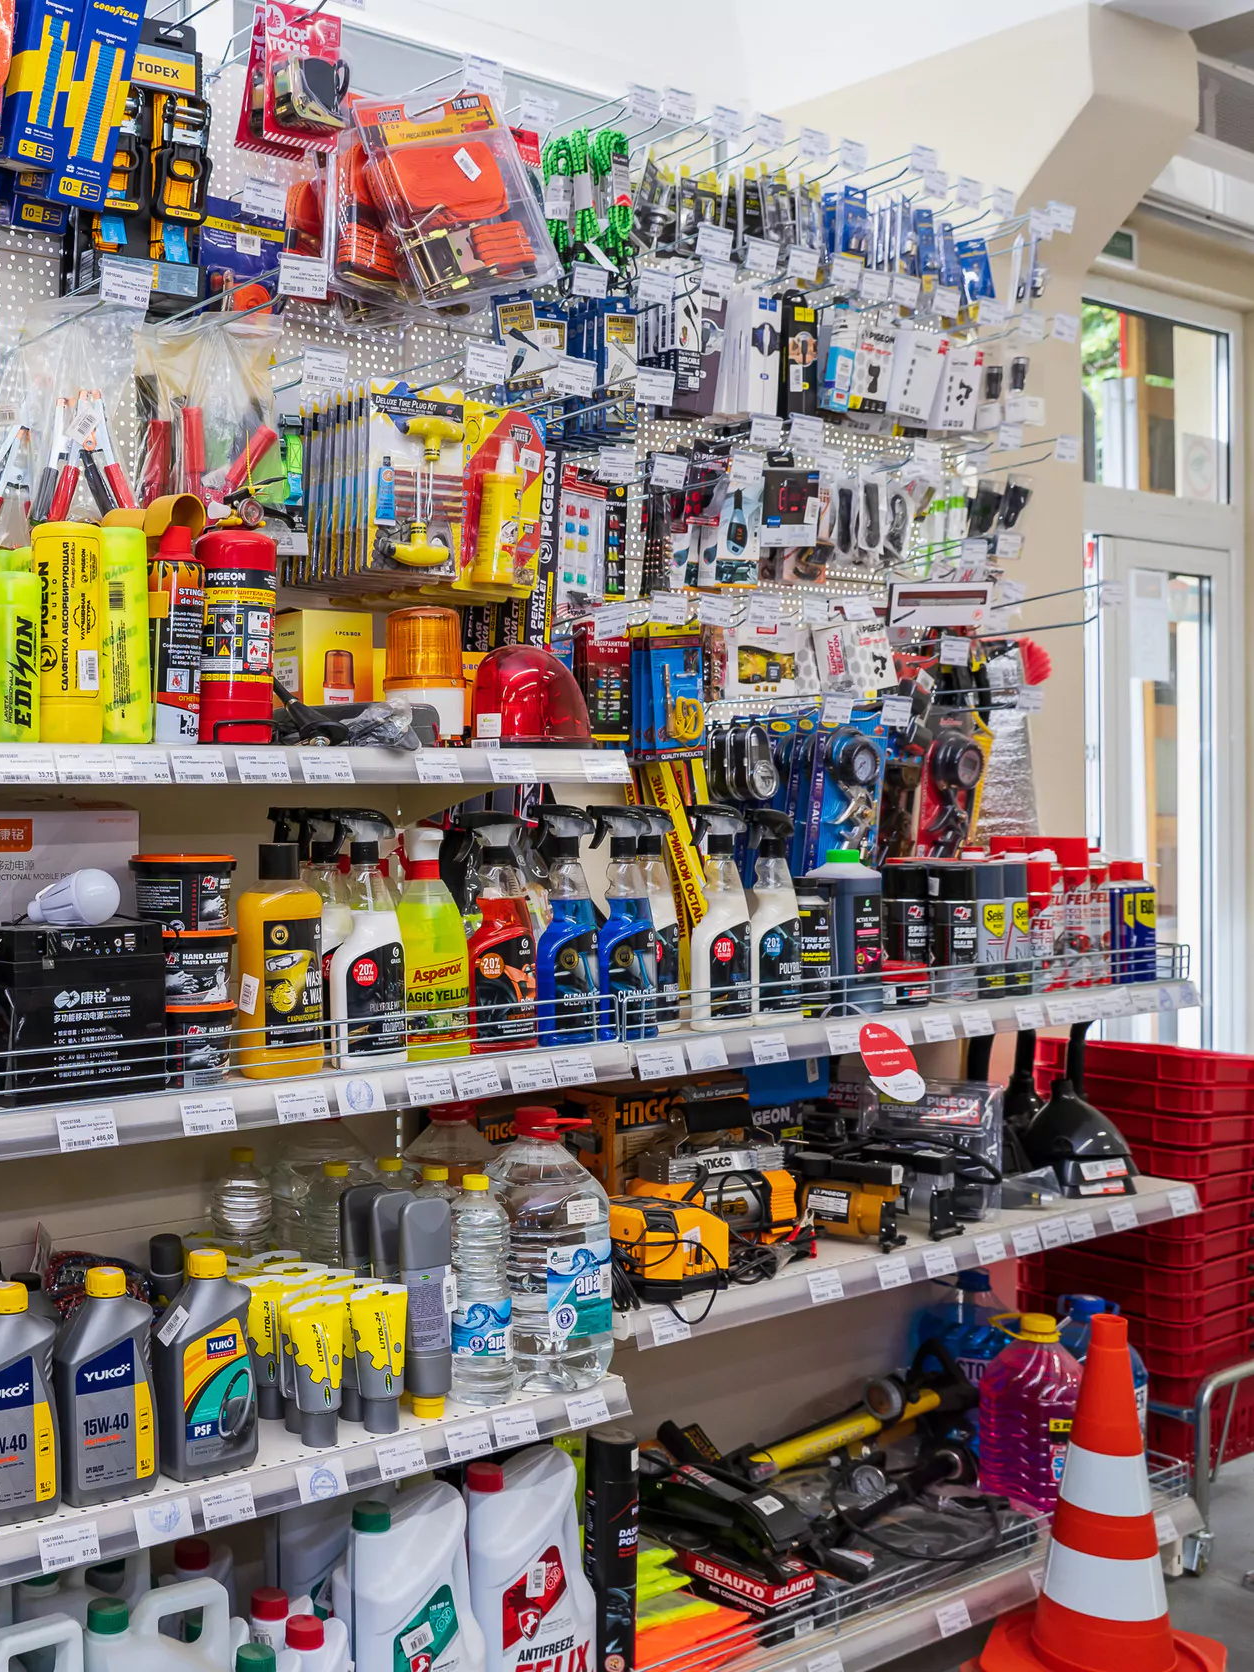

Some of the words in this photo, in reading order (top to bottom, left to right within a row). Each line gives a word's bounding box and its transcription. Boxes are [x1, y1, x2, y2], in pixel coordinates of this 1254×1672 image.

[284, 25, 309, 43] TOP
[269, 35, 310, 57] TOOLS
[137, 61, 180, 80] TOPEX
[377, 109, 403, 123] RATCHET
[61, 179, 73, 192] 10
[375, 394, 397, 405] DELUXE
[398, 398, 412, 407] TIRE
[412, 400, 428, 410] PLUG
[428, 401, 438, 412] KIT
[540, 449, 557, 536] PIGEON
[207, 572, 246, 581] PIGEON
[62, 541, 70, 637] АБСОРБИРУЮЩАЯ
[588, 639, 630, 649] ПРЕДОХРАНИТЕЛИ
[61, 638, 70, 692] САЛФЕТКА
[660, 752, 681, 760] QUALITY
[681, 751, 704, 759] PRODUCTS
[33, 872, 60, 880] MOBILE
[412, 963, 462, 983] Asperox
[80, 990, 107, 1005] 康铭
[112, 995, 131, 1003] KM-920
[406, 991, 434, 1004] AGIC
[53, 1010, 104, 1024] 多功能移动电源
[693, 1091, 706, 1100] Auto
[715, 1086, 744, 1098] Compressor
[927, 1095, 979, 1109] PIGEON
[220, 1118, 235, 1127] 47,00
[703, 1155, 732, 1169] INGCO
[821, 1189, 848, 1199] PIGEON
[379, 1311, 387, 1351] LITOL-24
[209, 1337, 234, 1352] YUKO
[315, 1323, 326, 1364] LITOL-24
[83, 1363, 129, 1383] YUKO
[83, 1412, 129, 1437] 15W-40
[193, 1423, 212, 1437] PSF
[82, 1546, 98, 1557] 87,00
[695, 1559, 766, 1599] BELAUTO
[773, 1576, 815, 1601] BELAUTO
[708, 1584, 720, 1594] AIR
[720, 1589, 767, 1616] COMPRESSOR
[517, 1635, 575, 1663] ANTIFREEZE
